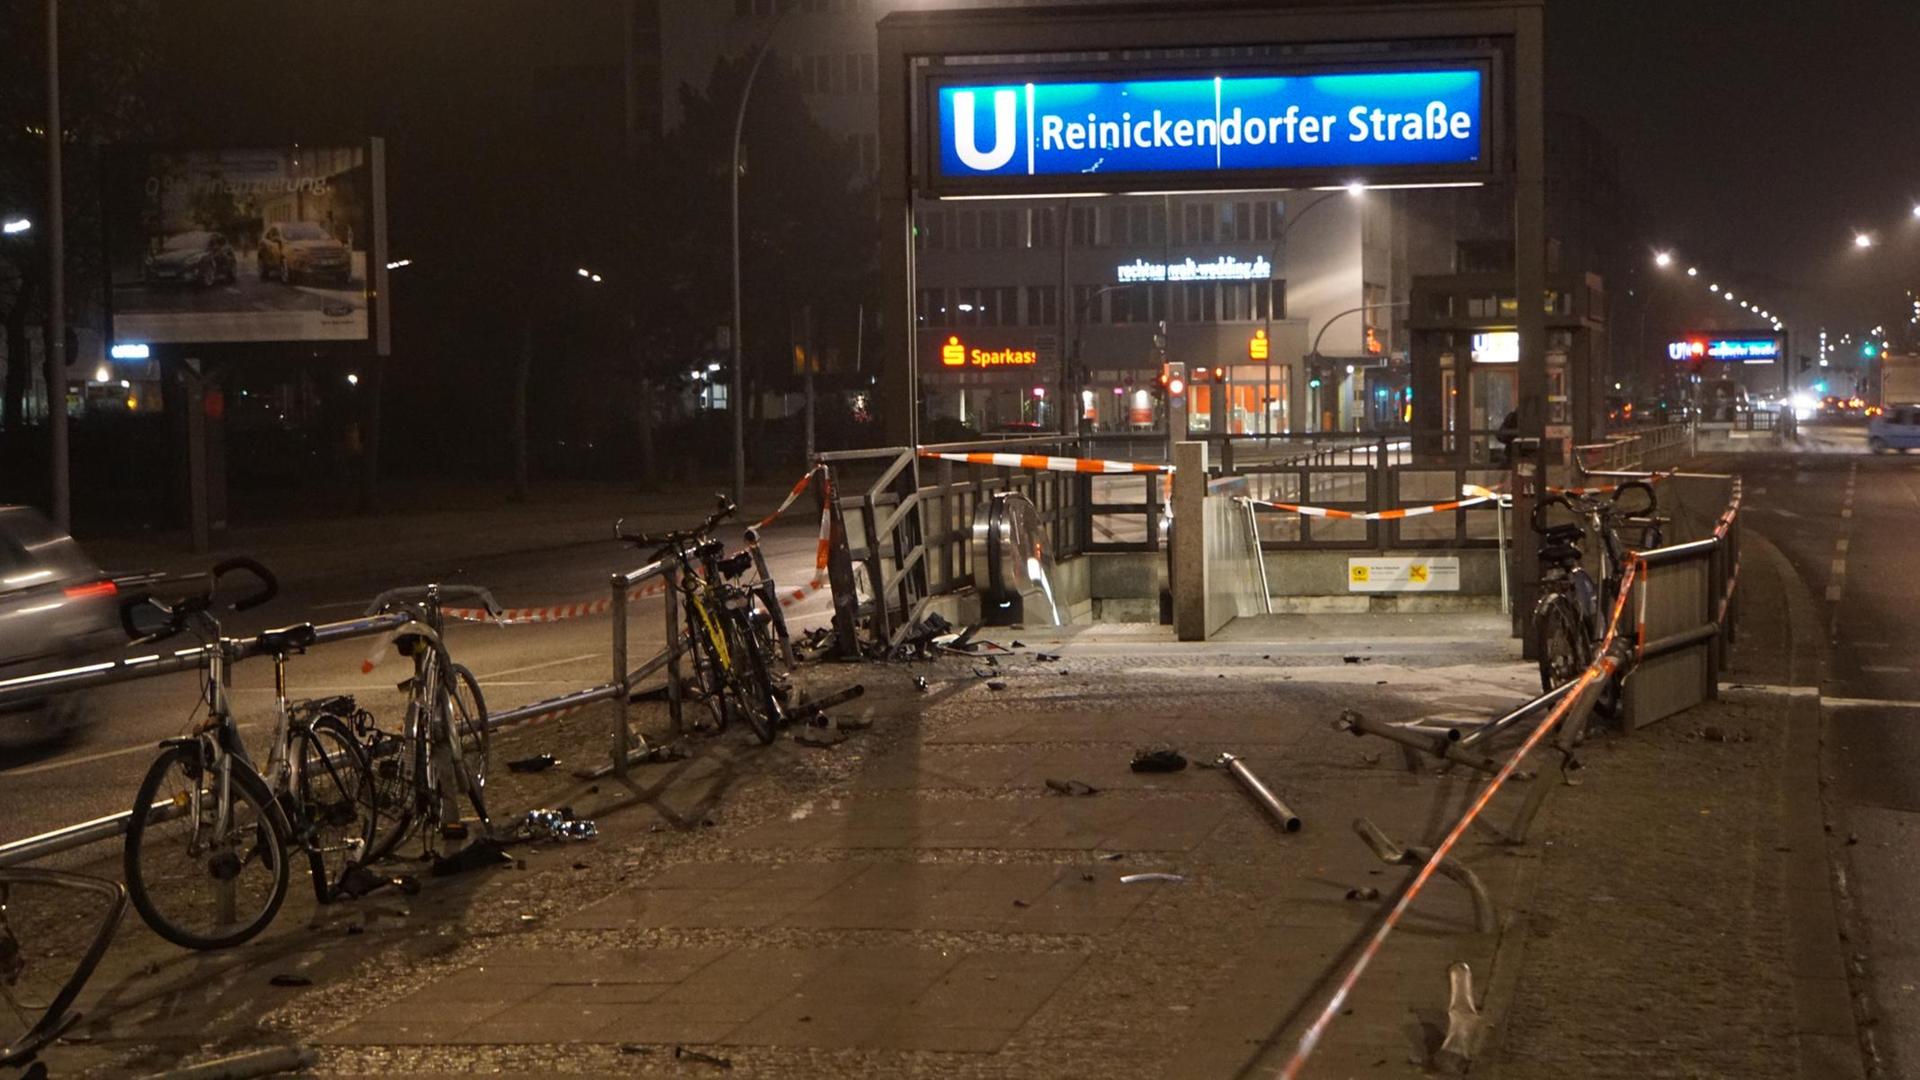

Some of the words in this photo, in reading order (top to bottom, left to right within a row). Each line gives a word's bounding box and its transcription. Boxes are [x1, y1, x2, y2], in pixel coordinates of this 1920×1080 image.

[953, 91, 1016, 170] U
[1042, 106, 1337, 151] Reinickendorfer
[1348, 101, 1472, 143] Straße
[971, 349, 1037, 367] Sparkas
